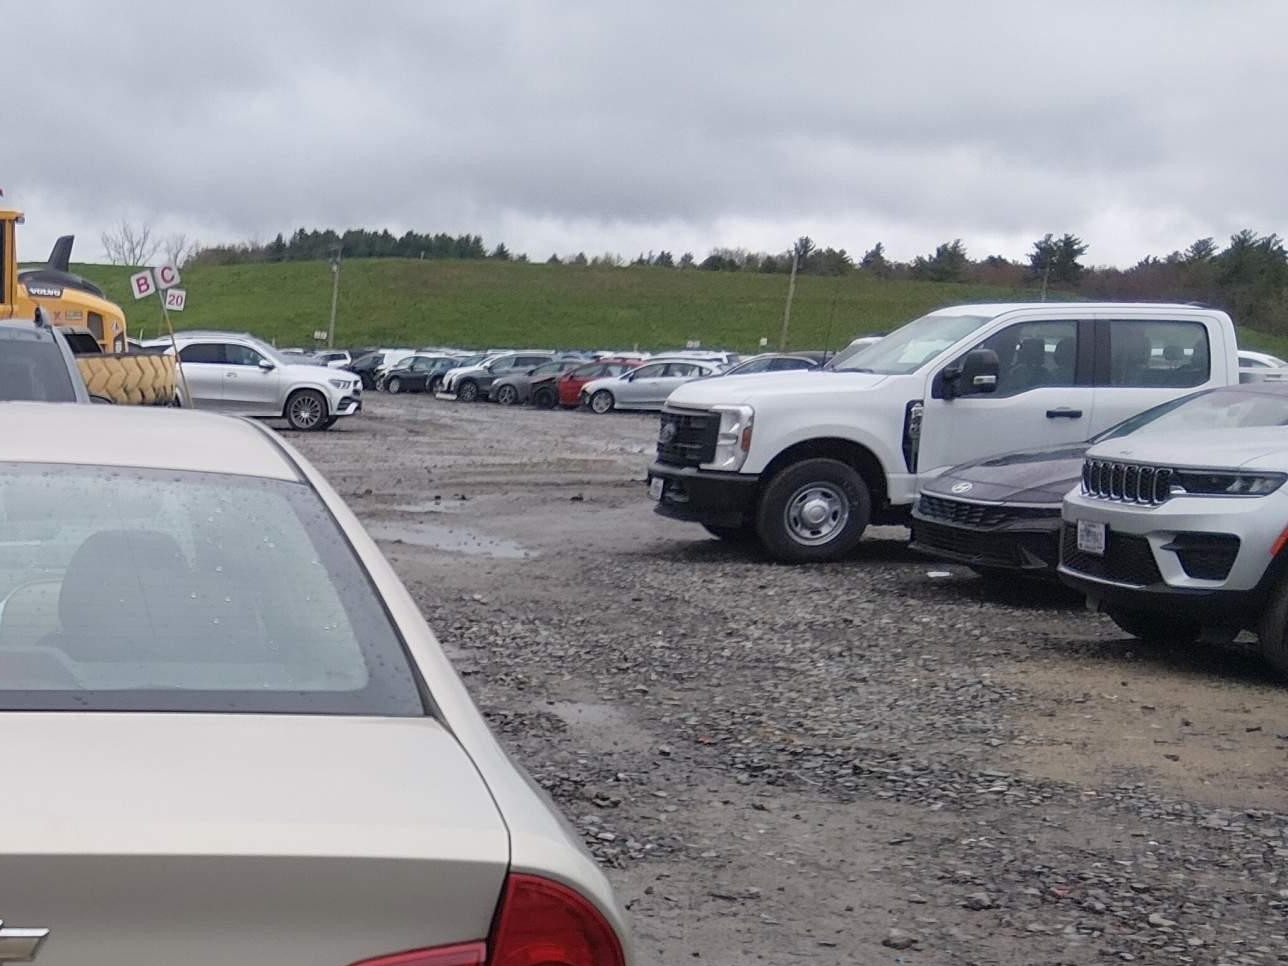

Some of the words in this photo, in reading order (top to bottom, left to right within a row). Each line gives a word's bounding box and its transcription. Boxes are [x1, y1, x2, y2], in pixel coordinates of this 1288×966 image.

[136, 276, 150, 294] B
[161, 266, 175, 284] C
[29, 287, 61, 297] VOLVO
[168, 294, 183, 306] 20
